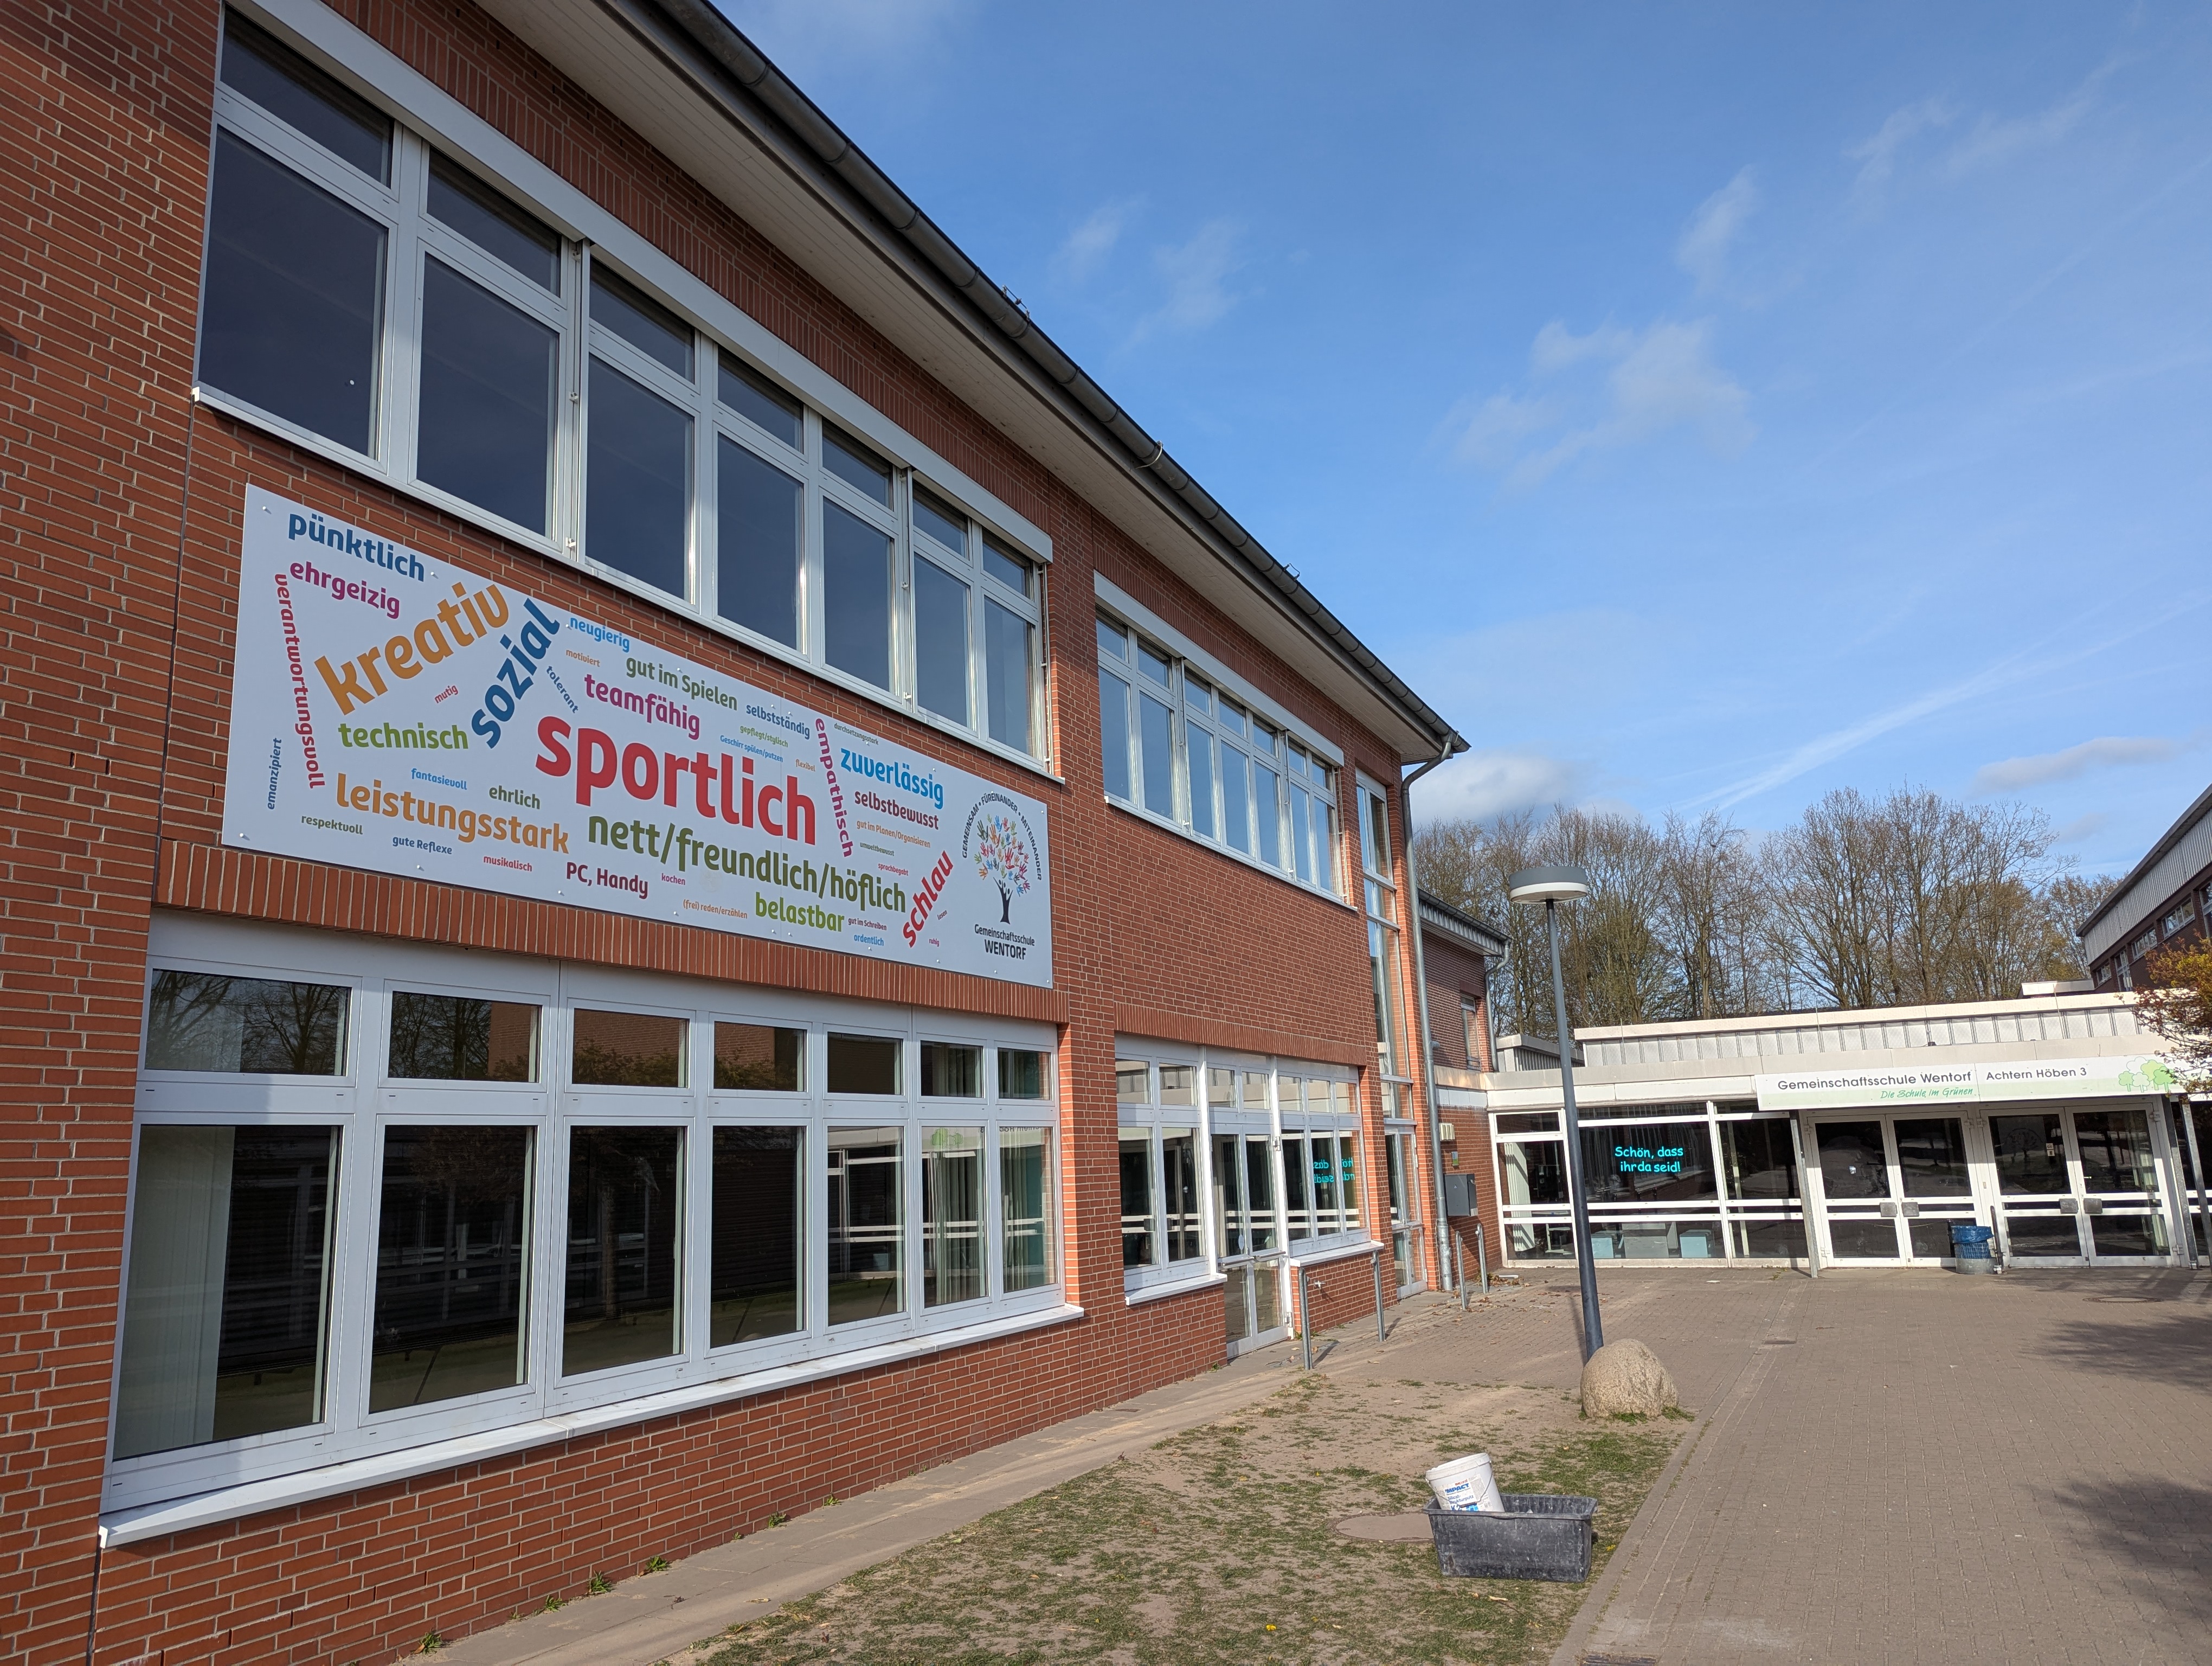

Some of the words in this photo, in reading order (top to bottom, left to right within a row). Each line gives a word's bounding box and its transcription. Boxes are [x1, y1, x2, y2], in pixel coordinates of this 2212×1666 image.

[288, 513, 425, 582] pünktlich
[290, 562, 400, 618] ehrgeizig
[314, 581, 509, 716] kreativ
[570, 618, 630, 652] neugierig
[565, 649, 600, 668] motiviert
[274, 574, 325, 789] verantwortungsvoll
[471, 598, 561, 749] sozial
[627, 657, 655, 679] gut
[659, 664, 678, 687] im
[681, 675, 737, 710] Spielen
[434, 684, 458, 704] mutig
[546, 665, 578, 714] tolerant
[584, 674, 699, 740] teamfähig
[338, 722, 468, 749] technisch
[746, 705, 810, 740] selbstständig
[834, 723, 878, 745] durchsetzungsstark
[720, 735, 743, 749] Geschirr
[744, 745, 783, 762] spülen/putzen
[740, 726, 788, 748] gepflegt/stylisch
[267, 738, 281, 810] emanzipiert
[411, 768, 467, 790] fantasievoll
[795, 759, 815, 772] flexibel
[840, 748, 943, 810] zuverlässig
[536, 716, 815, 845] sportlich
[815, 718, 853, 857] empathisch
[489, 786, 541, 810] ehrlich
[854, 791, 938, 830] selbstbewusst
[301, 815, 363, 835] respektvoll
[337, 773, 569, 854] leistungsstark
[392, 836, 415, 849] gute
[416, 839, 452, 855] Reflexe
[857, 821, 867, 829] gut
[867, 822, 874, 831] im
[876, 825, 930, 848] Planen/Organisieren
[962, 803, 979, 858] GEMEINSAM
[981, 793, 1018, 813] FÜREINANDER
[1021, 816, 1041, 880] MITEINANDER
[860, 842, 894, 856] umweltbewusst
[483, 855, 532, 872] musikalisch
[589, 816, 905, 913] nett/freundlich/höflich
[878, 863, 908, 876] sprachbegabt
[566, 862, 593, 886] PC,
[596, 866, 648, 899] Handy
[661, 873, 685, 886] kochen
[683, 899, 699, 911] (frei)
[700, 905, 747, 919] reden/erzählen
[756, 892, 844, 932] belastbar
[903, 850, 953, 948] schlau
[864, 920, 886, 931] Schreiben
[974, 924, 1035, 946] Gemeinschaftsschule
[854, 934, 884, 946] ordentlich
[985, 939, 1026, 960] WENTORF
[1778, 1075, 1916, 1090] Gemeinschaftsschule
[1920, 1071, 1971, 1084] Wentorf
[1986, 1071, 2033, 1080] Achtern
[2037, 1068, 2076, 1078] Höben
[2080, 1067, 2087, 1076] 3
[1881, 1090, 1895, 1099] Die
[1897, 1088, 1926, 1098] Schule
[1942, 1087, 1973, 1097] Grünen
[1615, 1146, 1654, 1159] Schön,
[1657, 1146, 1683, 1157] dass
[1654, 1161, 1681, 1172] seid!
